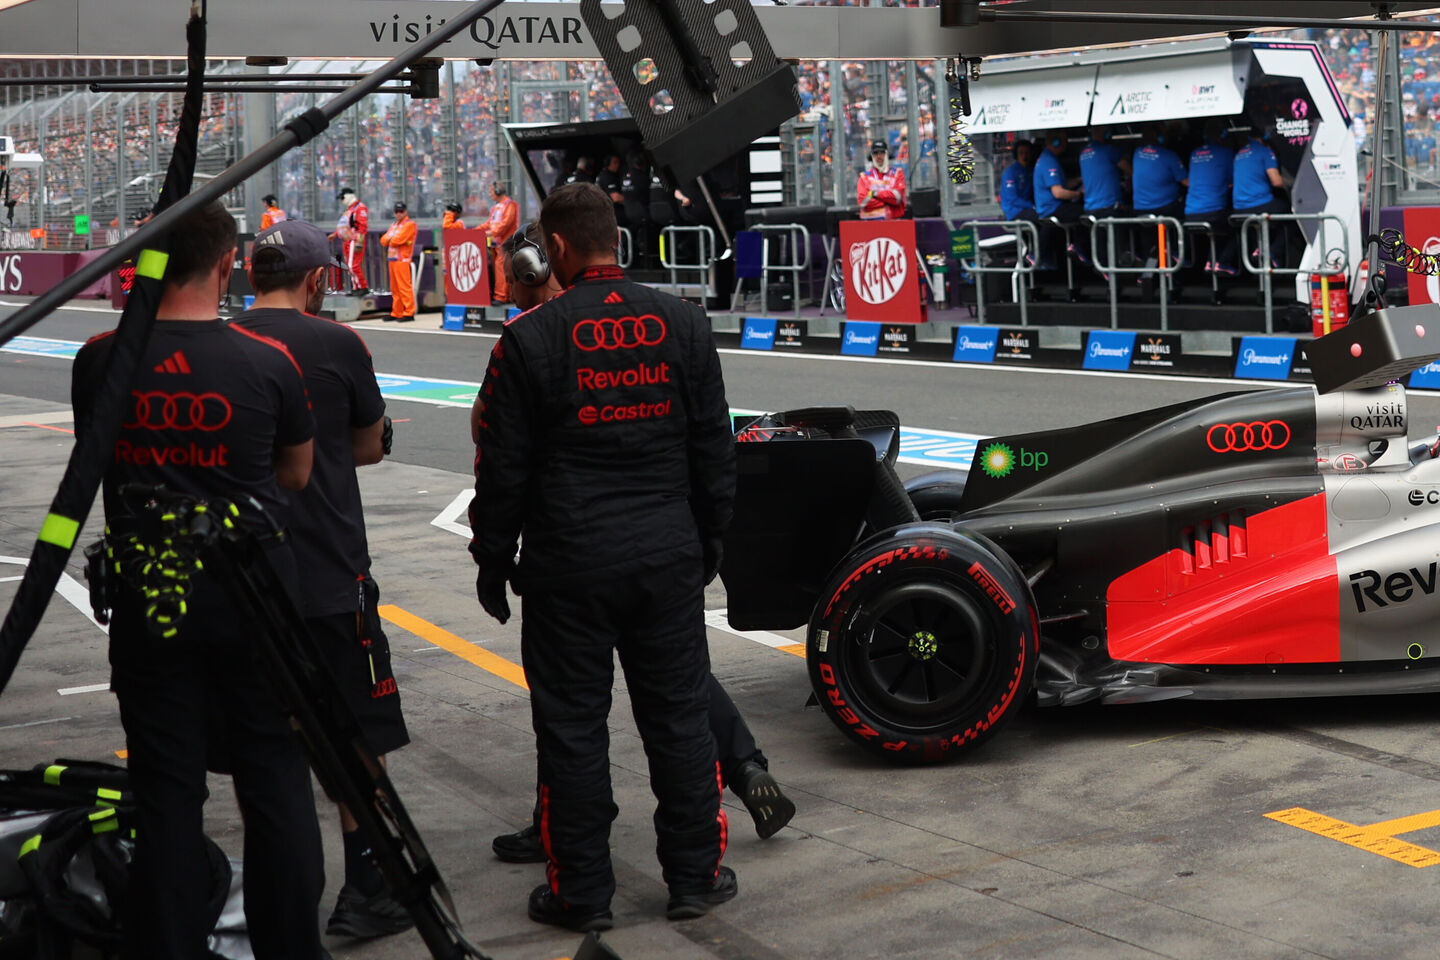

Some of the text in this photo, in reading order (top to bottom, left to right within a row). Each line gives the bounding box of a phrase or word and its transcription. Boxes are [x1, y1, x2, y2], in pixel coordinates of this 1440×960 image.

[469, 15, 584, 50] QATAR
[987, 104, 1011, 114] ARCTIC
[1125, 92, 1152, 102] ARCTIC
[1127, 103, 1148, 114] WOLF
[988, 115, 1006, 125] WOLF
[858, 239, 904, 302] KitKat
[1140, 344, 1171, 355] MARSHALS
[576, 362, 670, 392] Revolut
[600, 399, 672, 423] Castrol
[1366, 402, 1404, 415] visit
[1350, 415, 1404, 431] QATAR
[115, 439, 229, 468] Revolut
[1020, 447, 1049, 472] bp
[967, 561, 1017, 616] PIRELLI
[818, 662, 881, 741] ZERO
